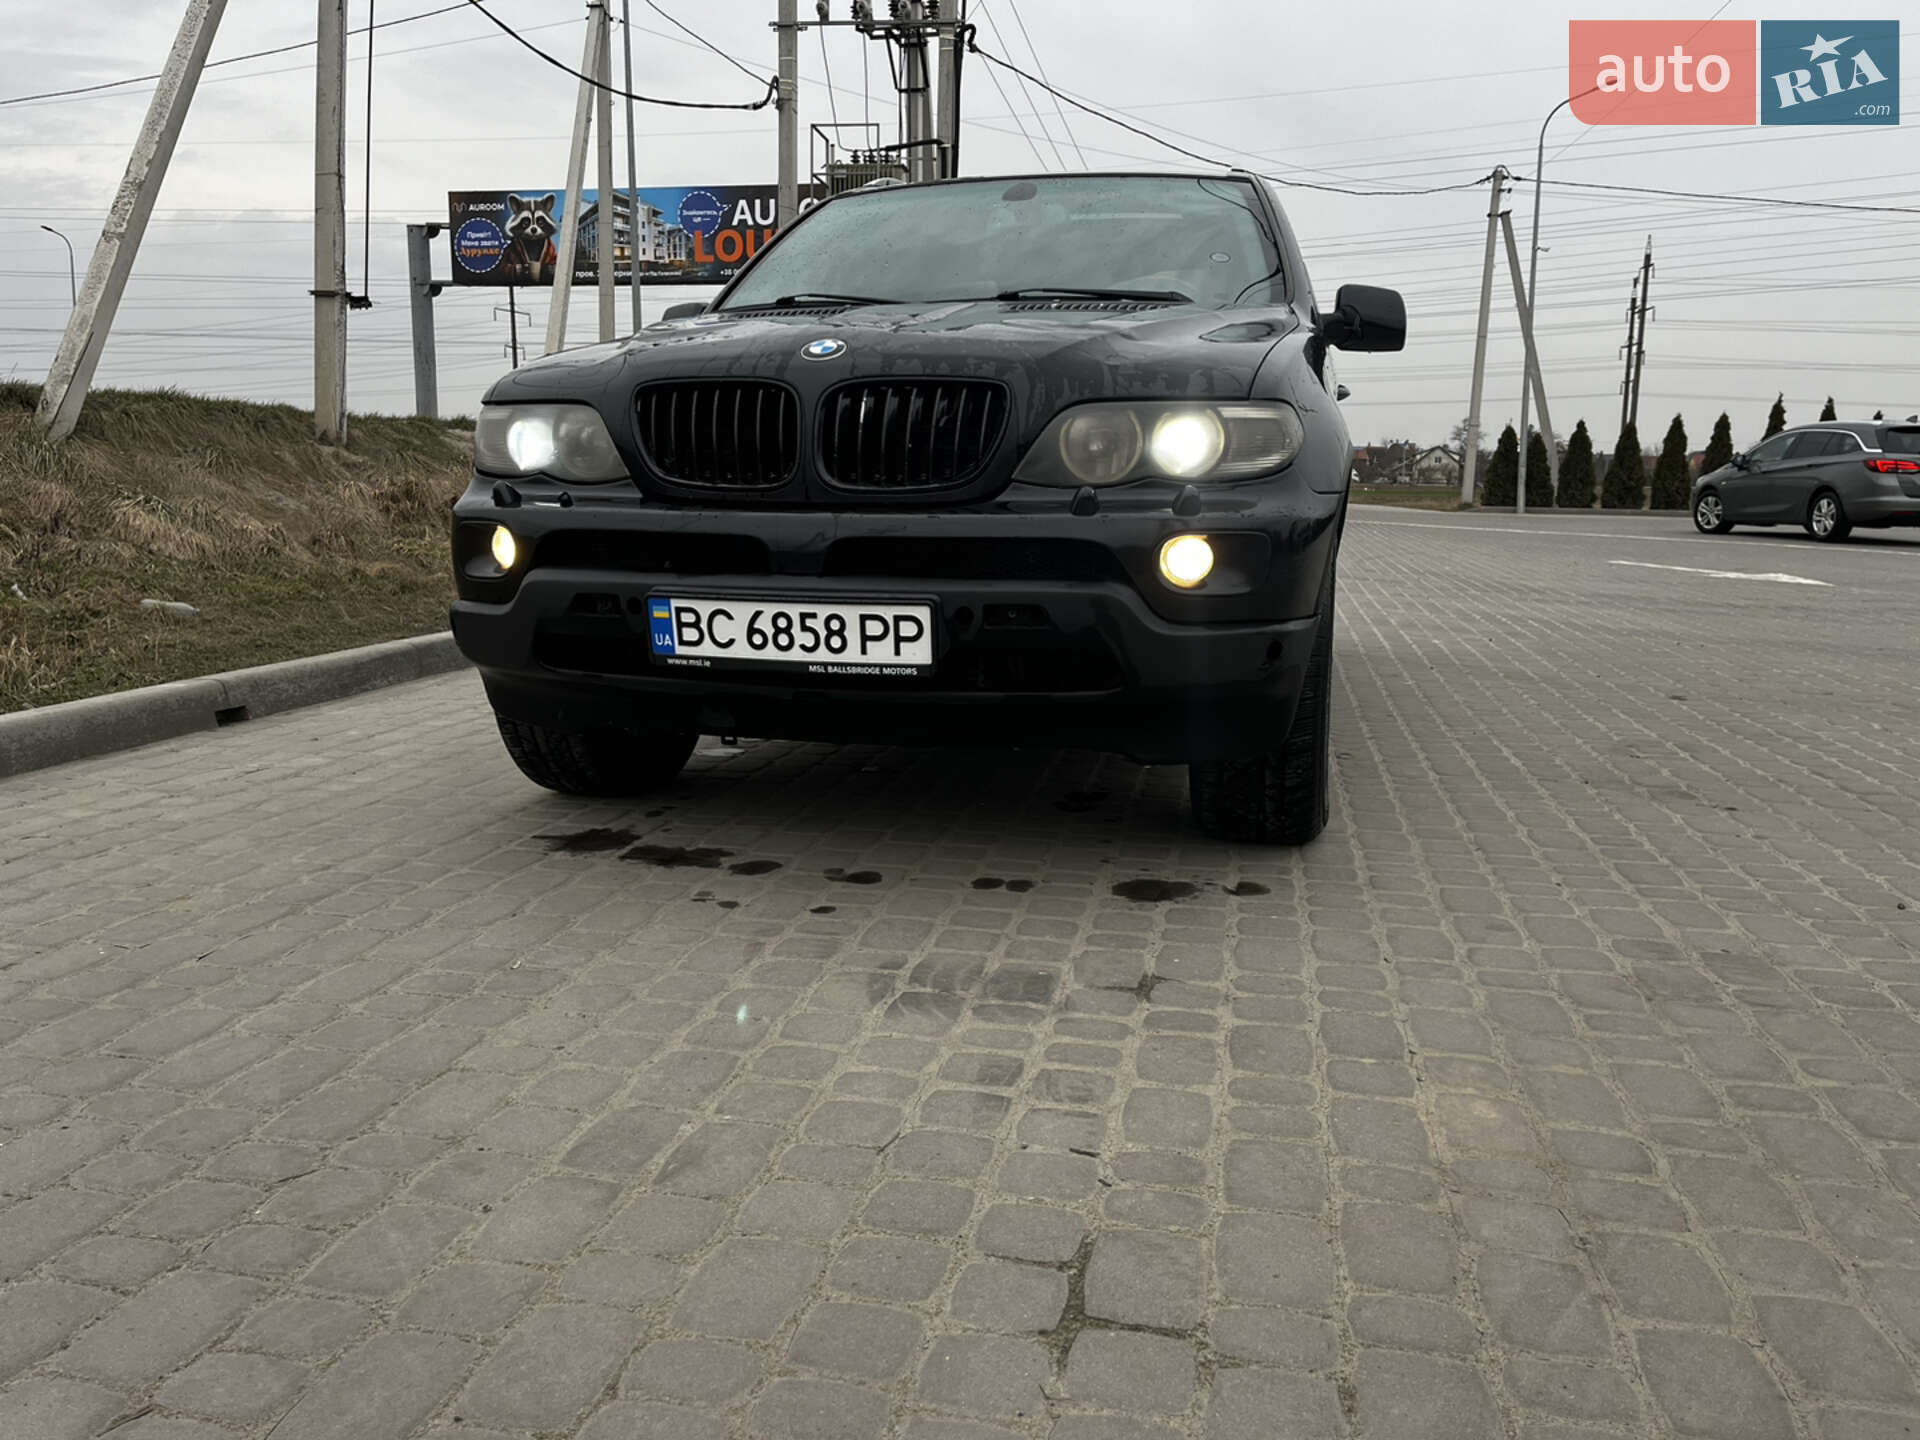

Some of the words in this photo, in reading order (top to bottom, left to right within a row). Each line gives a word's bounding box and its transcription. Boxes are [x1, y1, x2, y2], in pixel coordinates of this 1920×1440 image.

[469, 202, 505, 212] AUROOM
[694, 228, 779, 264] LOU
[674, 606, 736, 649] BC
[746, 610, 848, 655] 6858
[858, 613, 925, 657] PP
[655, 633, 672, 646] UA
[808, 665, 826, 673] MSL
[827, 665, 880, 675] BALLSBRIDGE
[882, 667, 918, 676] MOTORS
